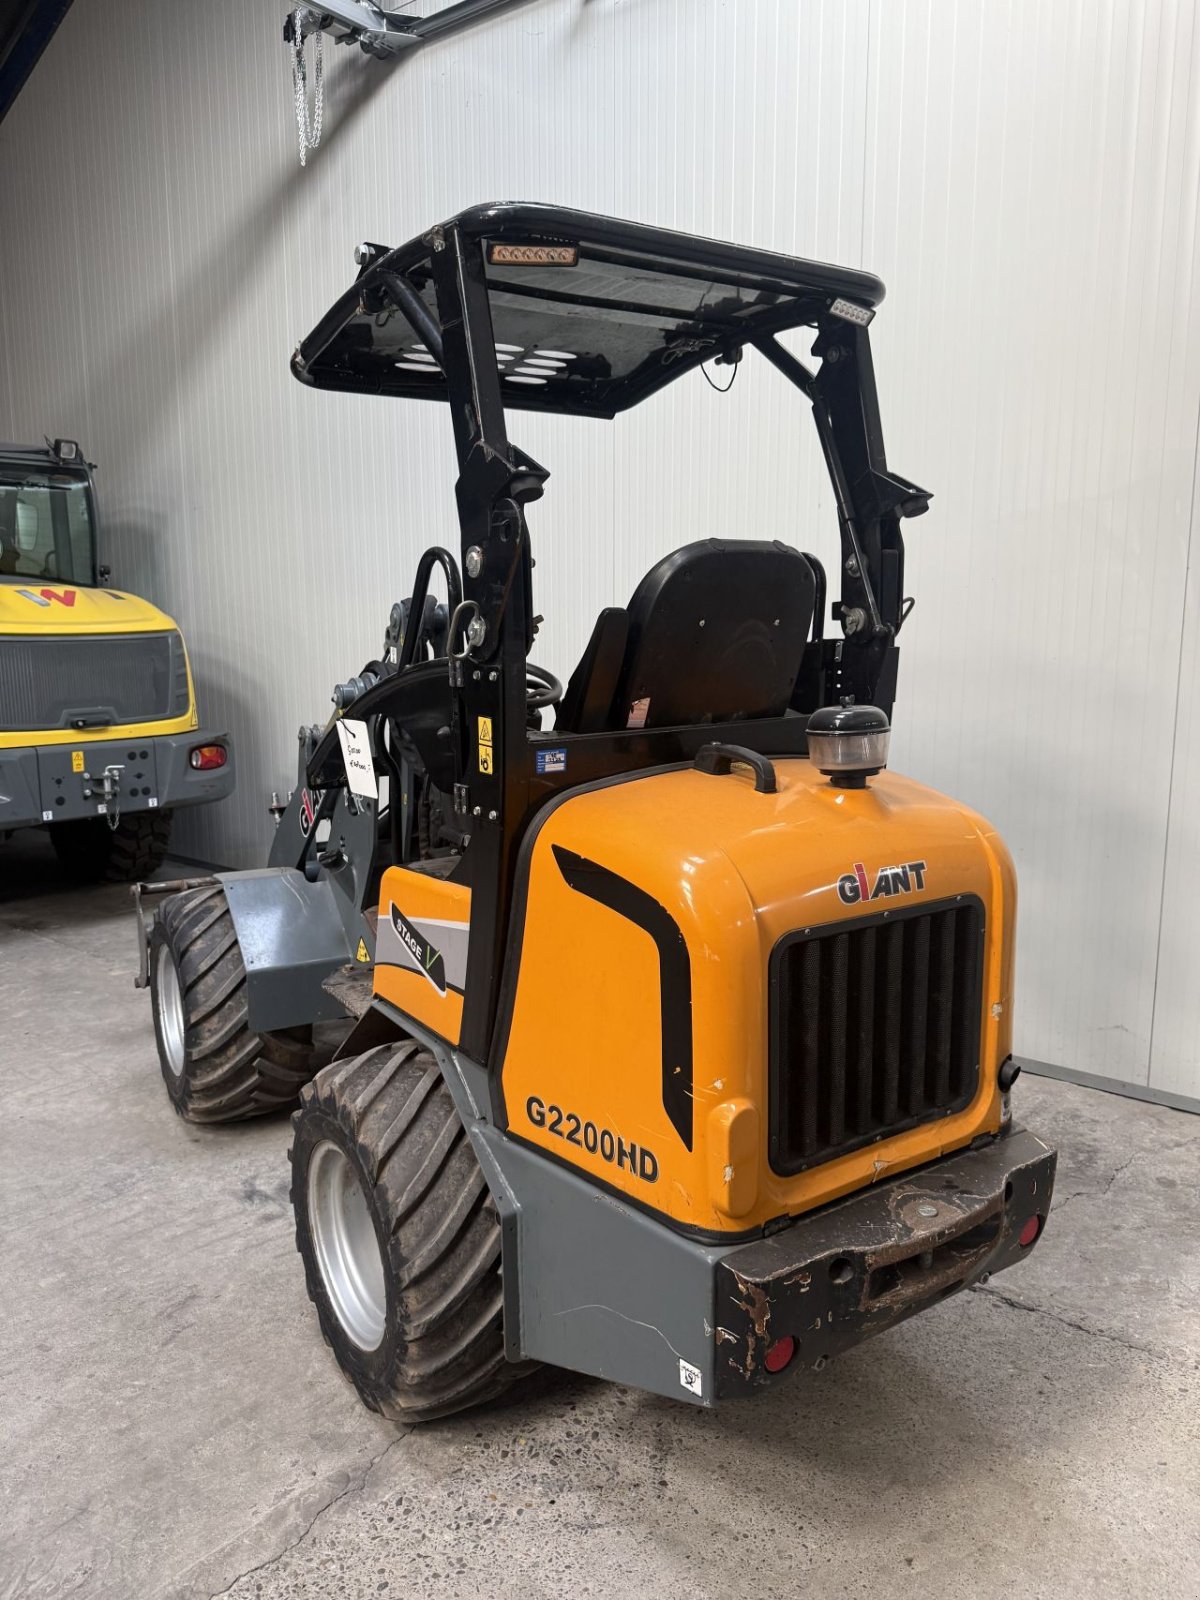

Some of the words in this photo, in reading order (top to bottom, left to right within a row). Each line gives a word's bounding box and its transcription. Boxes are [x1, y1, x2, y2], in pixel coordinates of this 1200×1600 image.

[396, 918, 423, 960] STAGE
[425, 944, 441, 970] V
[526, 1095, 659, 1183] G2200HD
